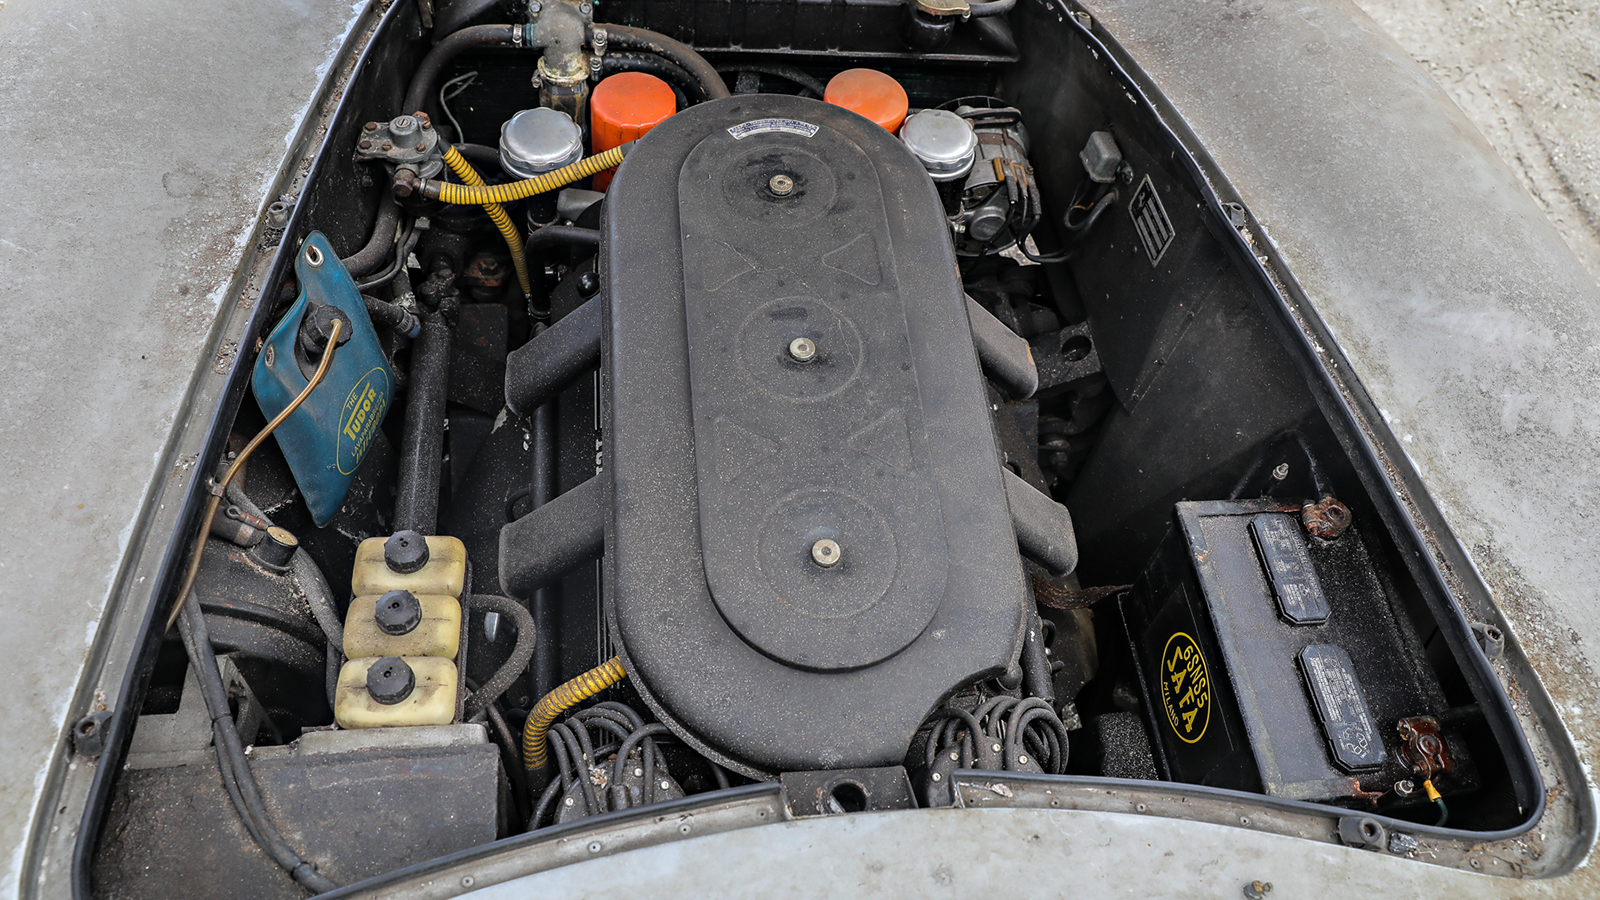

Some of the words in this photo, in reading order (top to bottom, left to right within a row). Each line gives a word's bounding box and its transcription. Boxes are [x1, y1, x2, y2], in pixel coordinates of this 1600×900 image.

[343, 381, 377, 441] TUDOR
[346, 391, 359, 410] THE
[1163, 681, 1179, 727] MILANO
[1167, 645, 1198, 733] SAFA
[1183, 645, 1208, 708] 6SNS5
